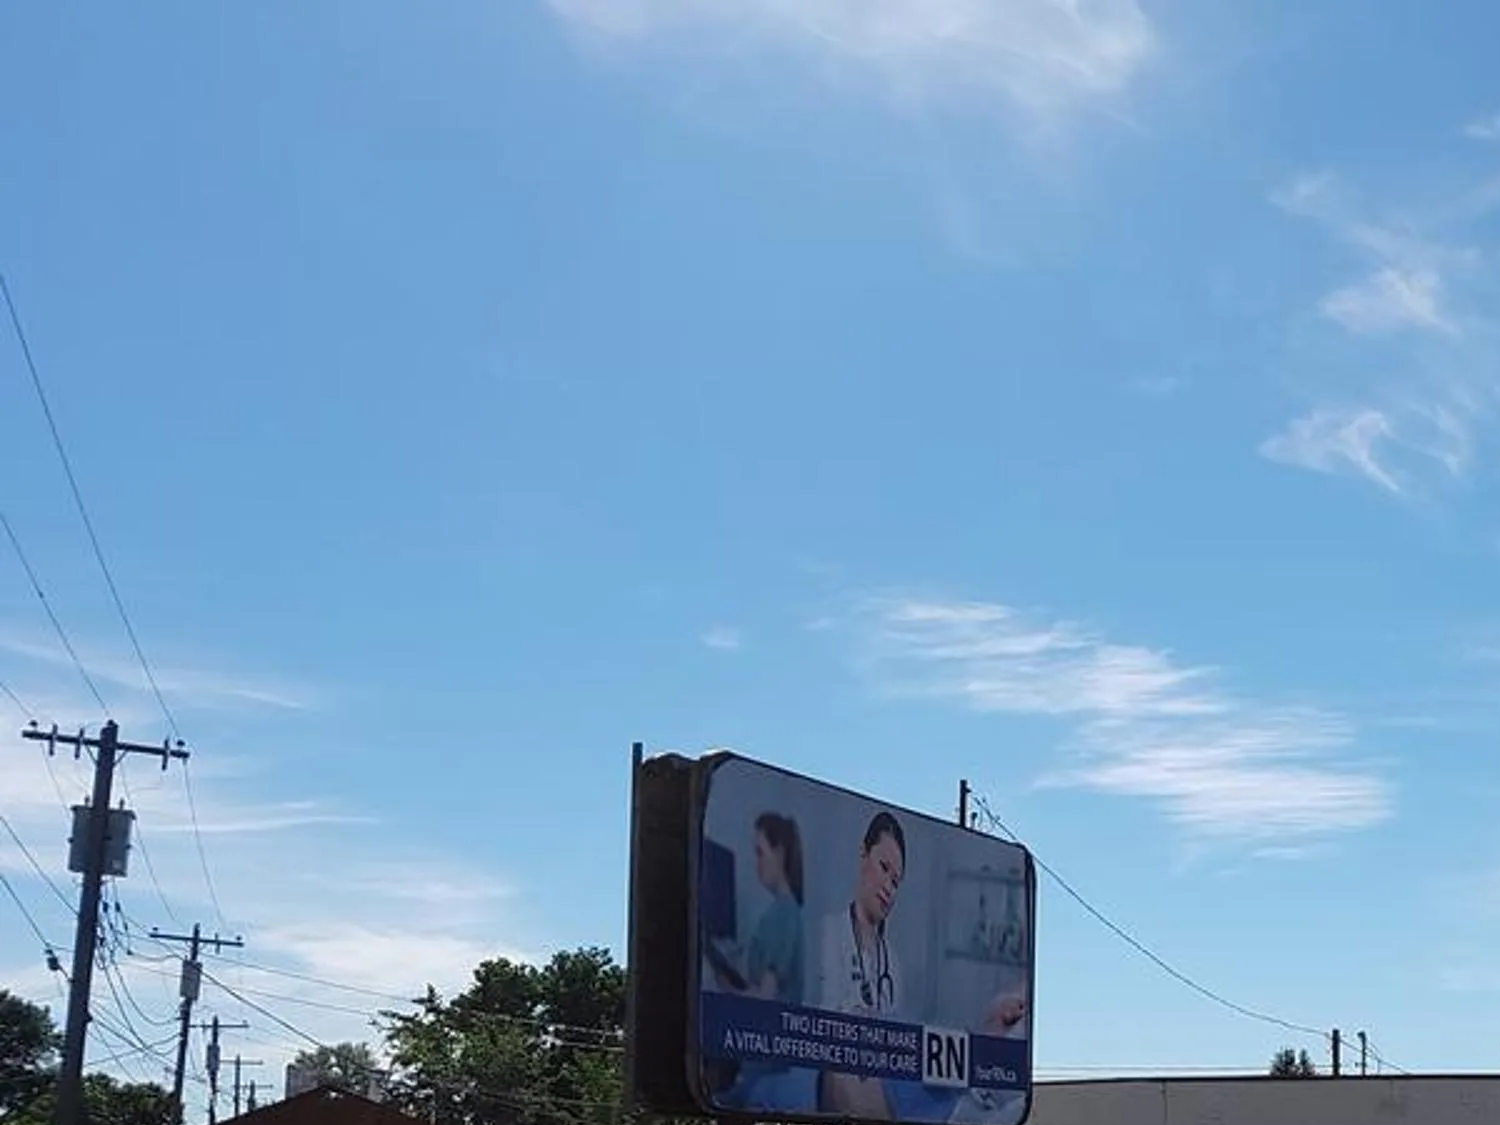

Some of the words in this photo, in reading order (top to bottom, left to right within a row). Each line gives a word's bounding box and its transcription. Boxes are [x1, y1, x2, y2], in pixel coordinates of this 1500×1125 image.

[723, 1028, 734, 1049] A
[734, 1029, 771, 1055] VITAL
[774, 1036, 842, 1064] DIFFERENCE
[844, 1046, 858, 1066] TO
[859, 1049, 888, 1070] YOUR
[889, 1052, 919, 1073] CARE
[781, 1011, 810, 1034] TWO
[812, 1018, 858, 1041] LETTERS
[860, 1026, 885, 1047] THAT
[887, 1029, 918, 1049] MAKE
[927, 1031, 965, 1081] RN
